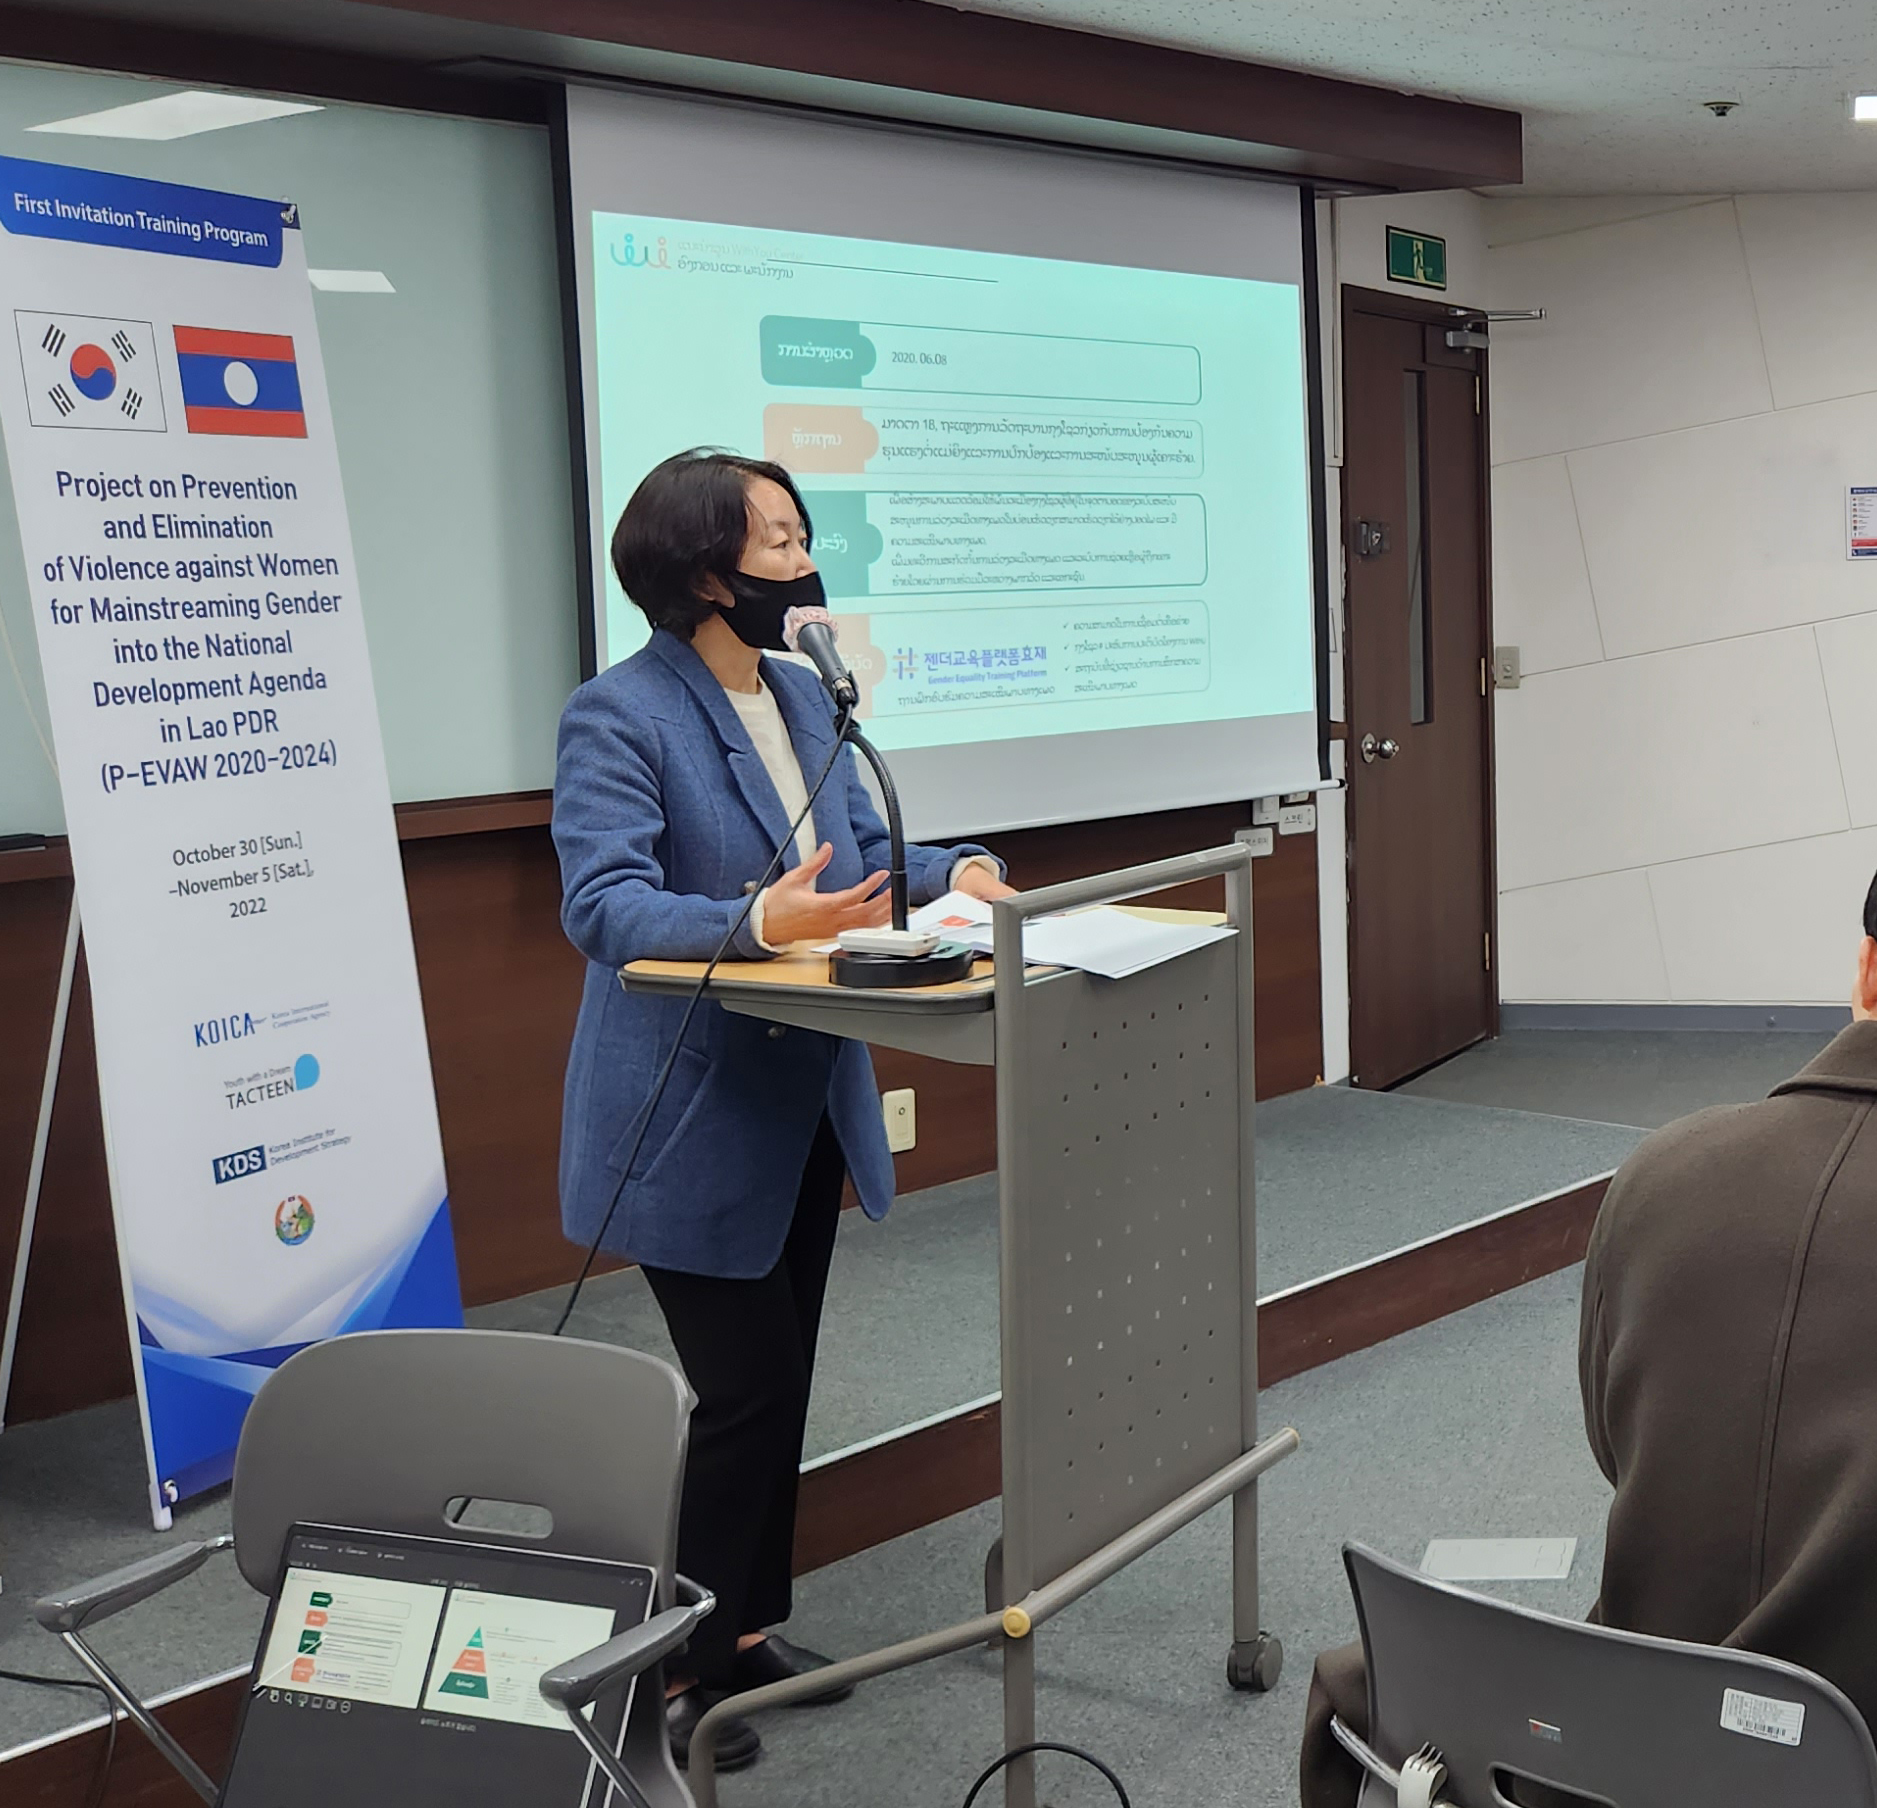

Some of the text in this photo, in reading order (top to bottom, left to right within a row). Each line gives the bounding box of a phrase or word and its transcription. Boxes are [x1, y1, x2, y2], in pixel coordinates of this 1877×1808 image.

[14, 193, 268, 248] First Invitation Training Program
[56, 471, 298, 501] Project on Prevention
[103, 514, 273, 539] and Elimination
[44, 553, 339, 582] of Violence against Women
[51, 591, 342, 624] for Mainstreaming Gender
[113, 630, 293, 664] into the National
[924, 644, 1048, 672] 젠더교육플랫폼효재
[93, 667, 327, 708] Development Agenda
[928, 669, 1048, 685] Gender Equality Training Platform
[160, 708, 279, 743] in Lao PDR
[101, 739, 338, 793] (P-EVAW 2020-2024)
[172, 831, 303, 867] October 30 [Sun.]
[262, 866, 271, 883] 5
[229, 897, 267, 918] 2022
[194, 1012, 256, 1048] KOICA
[225, 1077, 295, 1110] TACTEEN
[269, 1142, 291, 1153] Korea
[292, 1132, 323, 1147] Institute
[270, 1135, 352, 1166] Development Strategy
[218, 1149, 263, 1181] KDS
